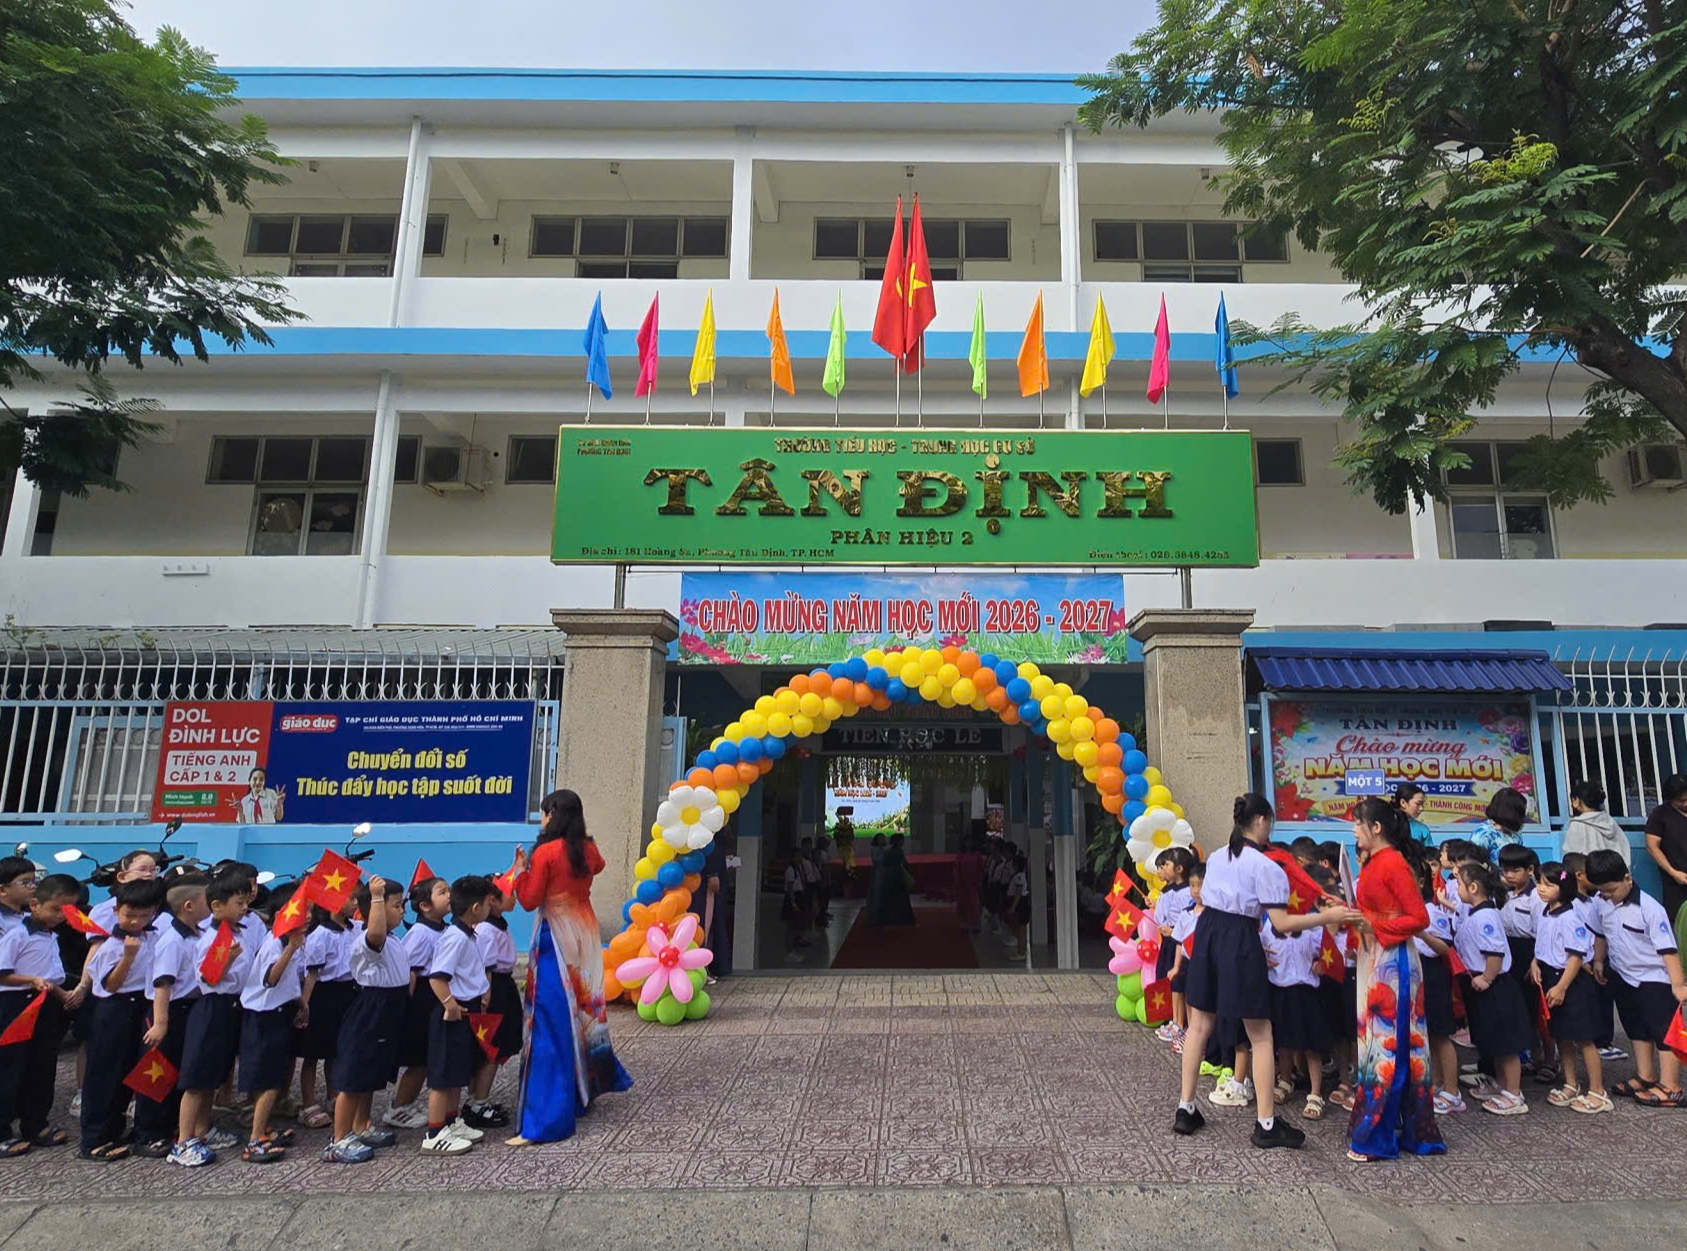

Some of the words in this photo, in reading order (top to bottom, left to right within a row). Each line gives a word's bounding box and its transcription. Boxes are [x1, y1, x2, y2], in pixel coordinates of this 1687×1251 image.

[643, 457, 870, 517] TÂN
[896, 453, 1174, 534] ĐỊNH
[831, 528, 891, 545] PHÂN
[899, 528, 953, 547] HIỆU
[961, 530, 974, 545] 2
[625, 547, 641, 556] 181
[698, 589, 759, 634] CHÀO
[763, 590, 829, 634] MỪNG
[832, 592, 882, 634] NĂM
[887, 598, 933, 640] HỌC
[938, 590, 980, 634] MỚI
[985, 599, 1040, 634] 2026
[1045, 615, 1055, 626] -
[1059, 599, 1113, 634] 2027
[172, 708, 212, 723] DOL
[281, 716, 311, 730] giáo
[345, 716, 361, 724] TẠP
[363, 715, 378, 723] CHÍ
[379, 715, 399, 723] GIÁO
[401, 716, 419, 724] DỤC
[420, 715, 448, 723] THÀNH
[470, 714, 481, 722] HỒ
[483, 714, 499, 722] CHÍ
[1339, 714, 1389, 730] TÂN
[1396, 719, 1458, 733] ĐỊNH
[168, 725, 216, 743] ĐÌNH
[220, 726, 260, 747] LỰC
[1335, 734, 1397, 755] Chào
[1399, 736, 1468, 759] mừng
[172, 752, 216, 766] TIẾNG
[220, 755, 251, 766] ANH
[347, 748, 411, 770] Chuyển
[415, 748, 442, 769] đổi
[446, 749, 469, 769] số
[1304, 754, 1374, 780] NĂM
[1378, 757, 1440, 780] HỌC
[1444, 755, 1504, 780] MỚI
[169, 767, 200, 782] CẤP
[204, 771, 210, 782] 1
[213, 771, 223, 782] &
[228, 771, 236, 782] 2
[1347, 775, 1373, 788] MỘT
[1374, 777, 1383, 787] 5
[296, 777, 338, 796] Thúc
[341, 774, 373, 797] đẩy
[376, 777, 408, 799] học
[412, 777, 440, 799] tập
[443, 775, 482, 795] suốt
[484, 775, 513, 795] đời
[1439, 784, 1466, 793] 2027
